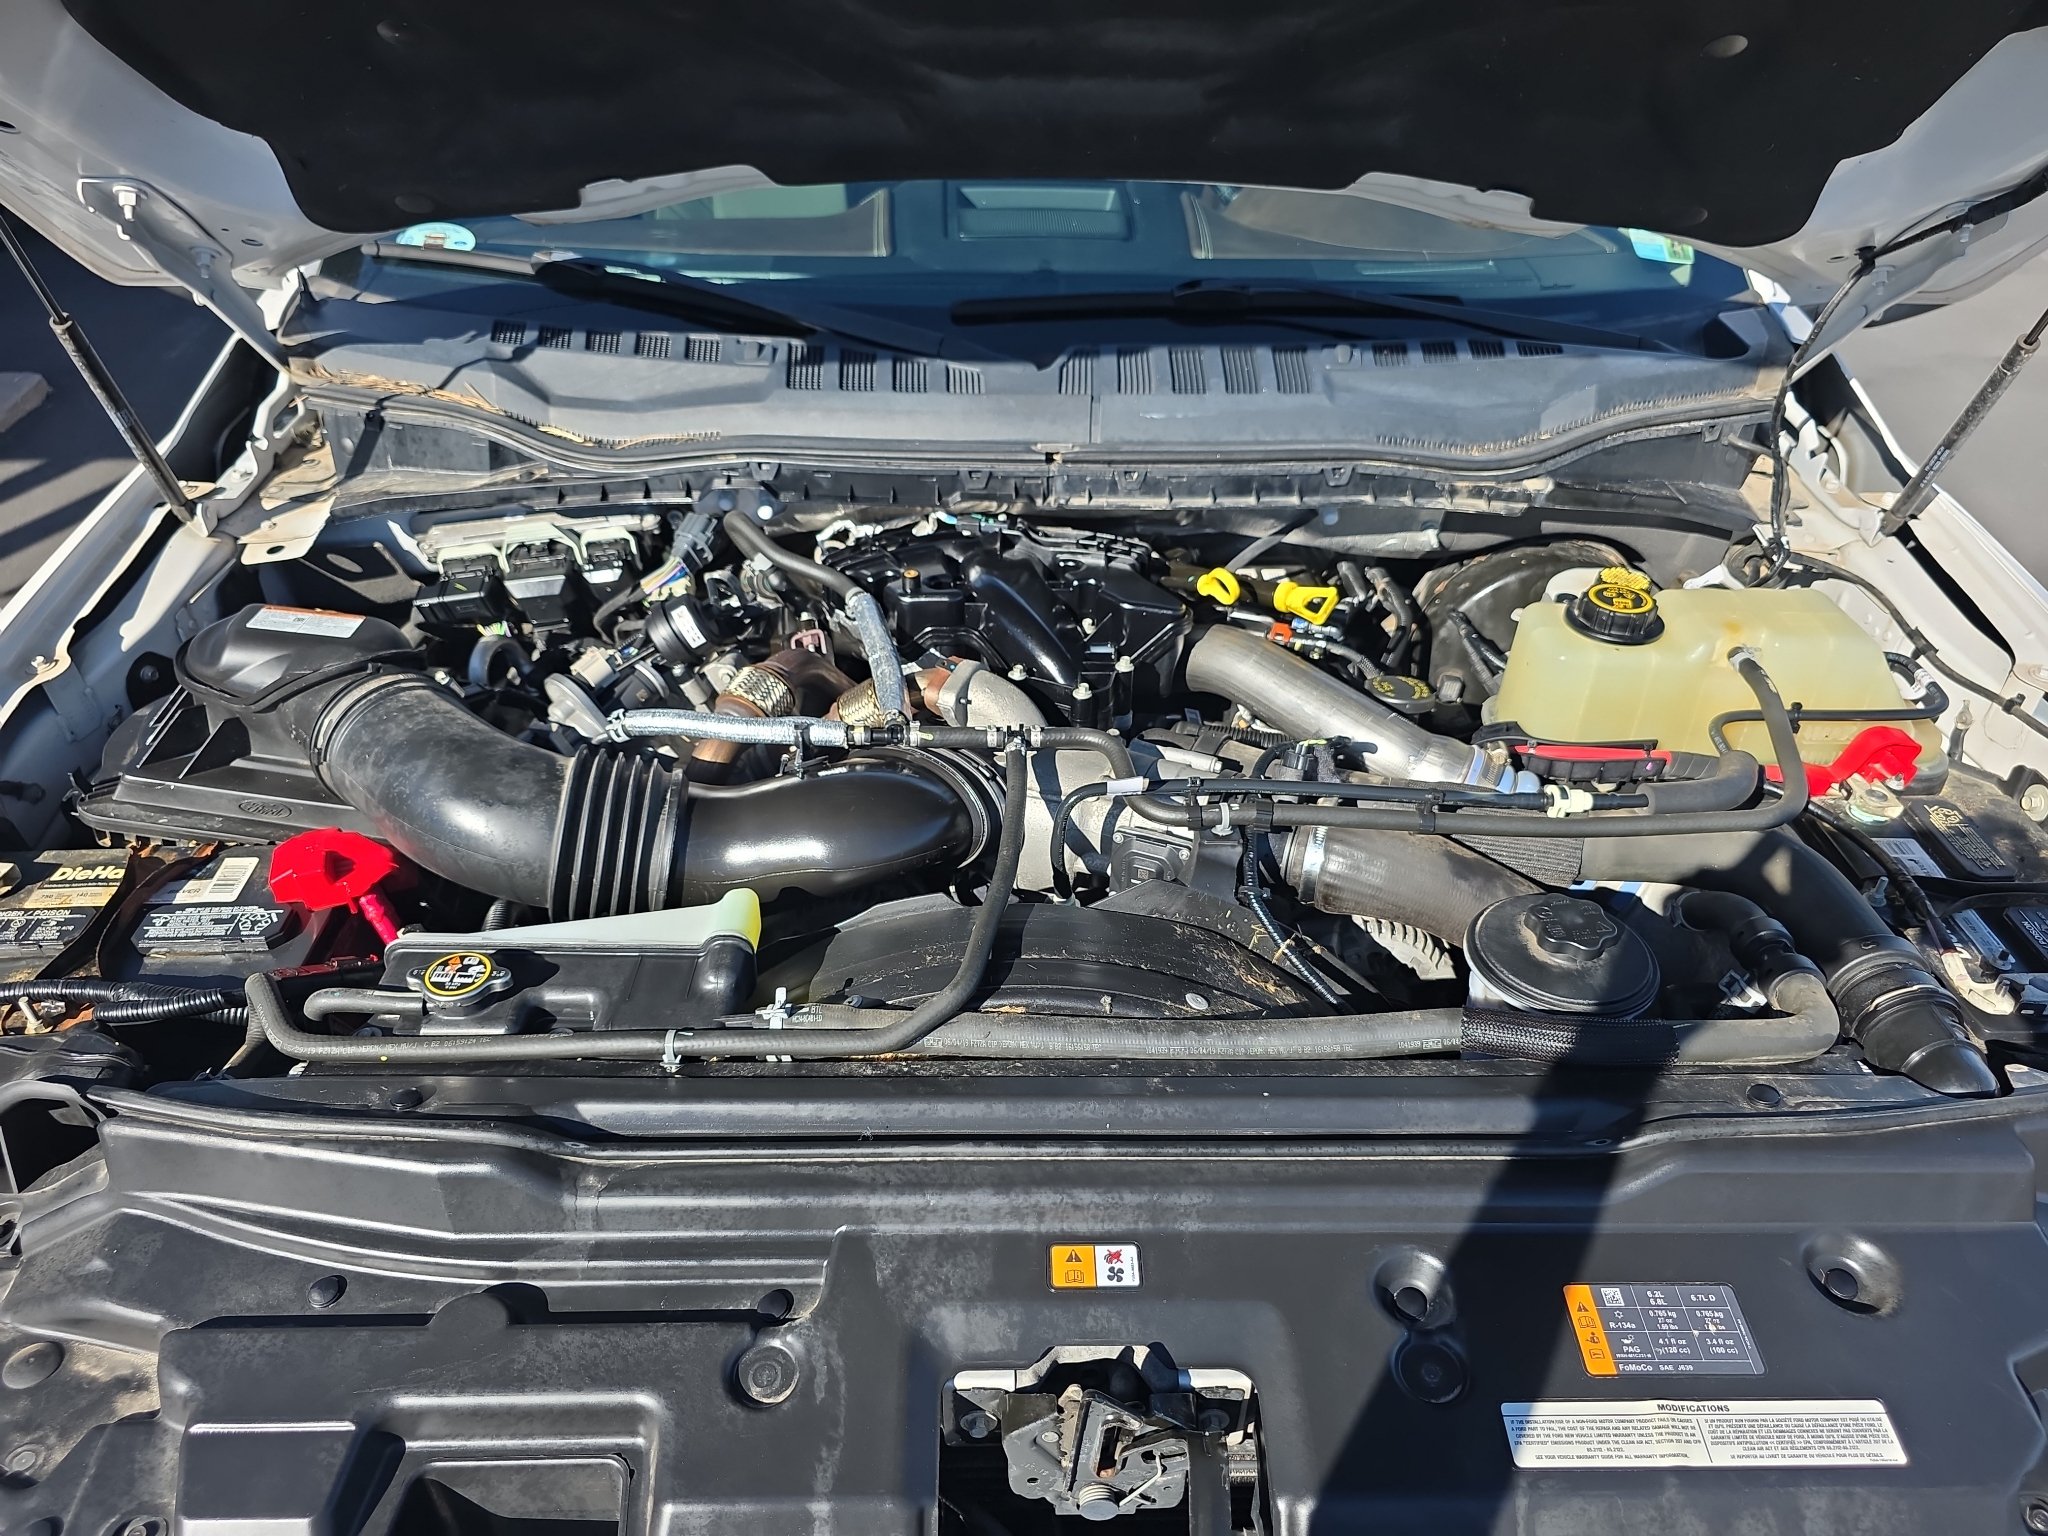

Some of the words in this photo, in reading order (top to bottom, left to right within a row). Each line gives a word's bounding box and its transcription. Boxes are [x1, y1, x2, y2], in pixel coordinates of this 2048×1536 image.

[50, 866, 126, 882] DieHa
[2022, 920, 2047, 946] POISON
[1667, 1310, 1677, 1318] kg
[1714, 1310, 1724, 1318] kg
[1609, 1321, 1636, 1329] R-134a
[1656, 1403, 1730, 1412] MODIFICATIONS
